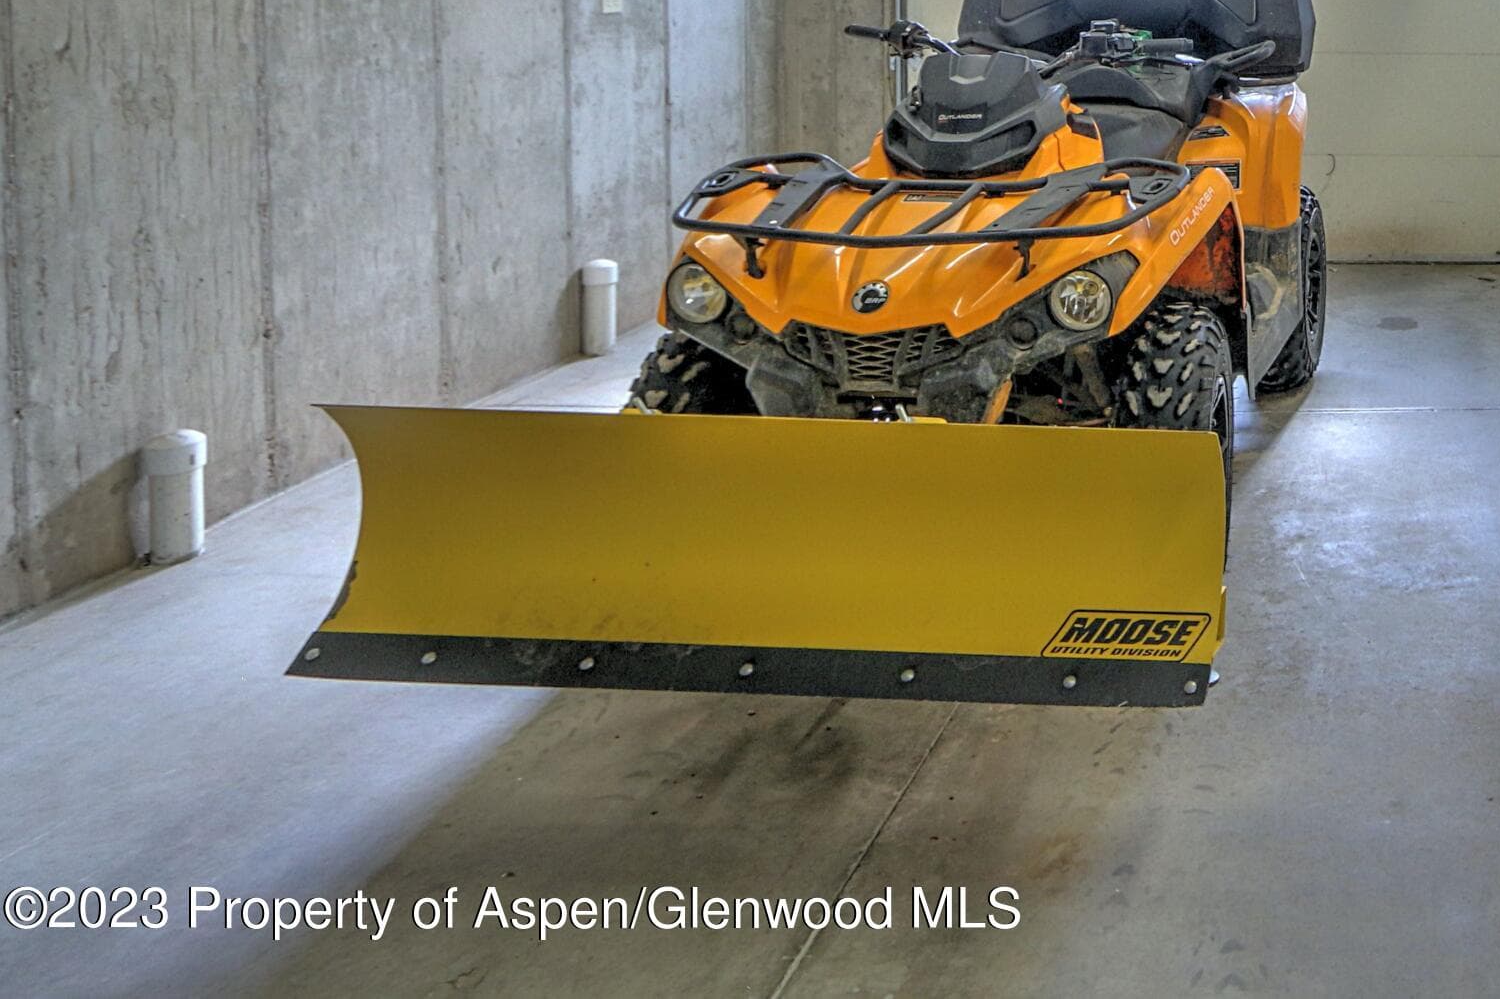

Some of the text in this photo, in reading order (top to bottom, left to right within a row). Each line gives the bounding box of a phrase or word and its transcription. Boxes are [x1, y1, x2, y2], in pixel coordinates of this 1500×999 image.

[1169, 186, 1215, 246] OUTLANDER
[1059, 617, 1200, 646] MOOSE
[1050, 646, 1182, 658] UTILITY DIVISION
